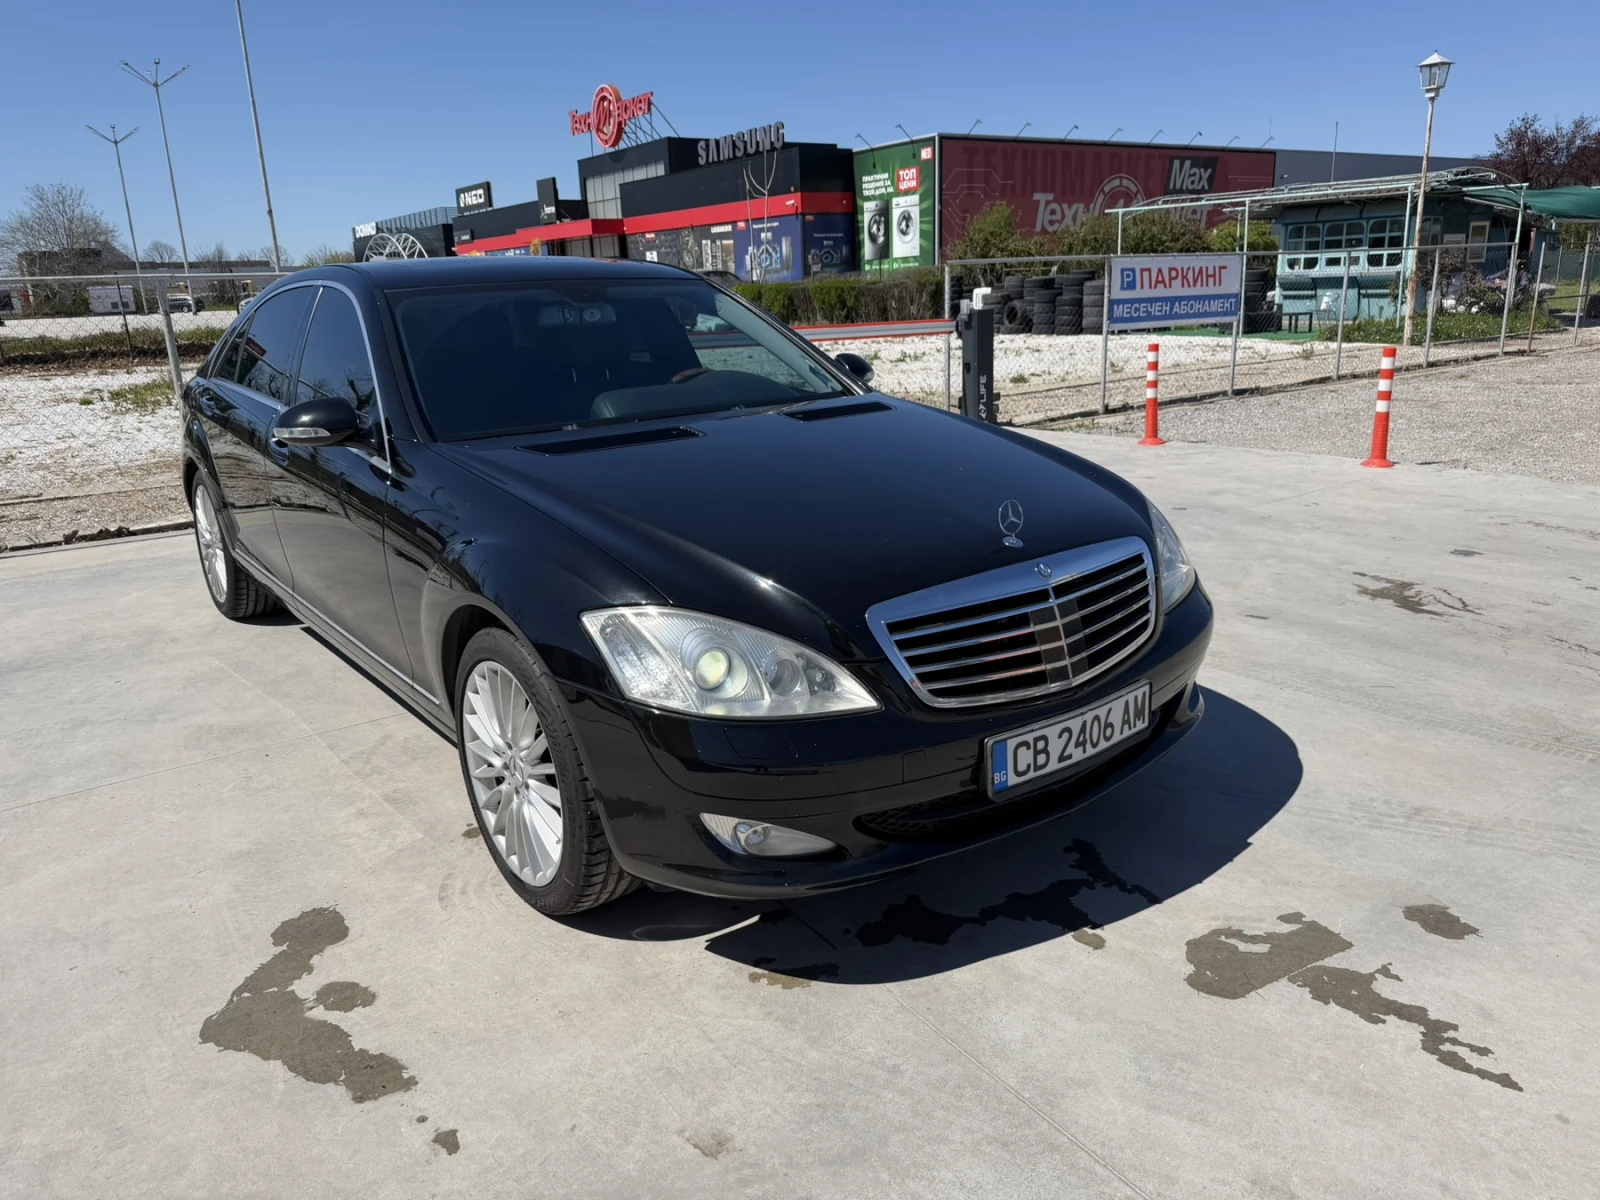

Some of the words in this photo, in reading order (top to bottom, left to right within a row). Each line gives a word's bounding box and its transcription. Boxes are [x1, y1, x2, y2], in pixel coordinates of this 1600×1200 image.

[697, 121, 785, 166] SAMSUNG
[921, 148, 933, 160] NEO
[898, 168, 917, 181] ТОП
[1169, 159, 1212, 190] Max
[898, 179, 917, 191] ЦЕНИ
[465, 188, 485, 206] NEO
[1139, 265, 1228, 290] ПАРКИНГ
[1113, 301, 1170, 319] МЕСЕЧЕН
[1171, 298, 1237, 315] АБОНАМЕНТ
[1013, 734, 1050, 778] CB
[1057, 707, 1115, 765] 2406
[1119, 691, 1147, 736] AM
[994, 770, 1007, 784] BG
